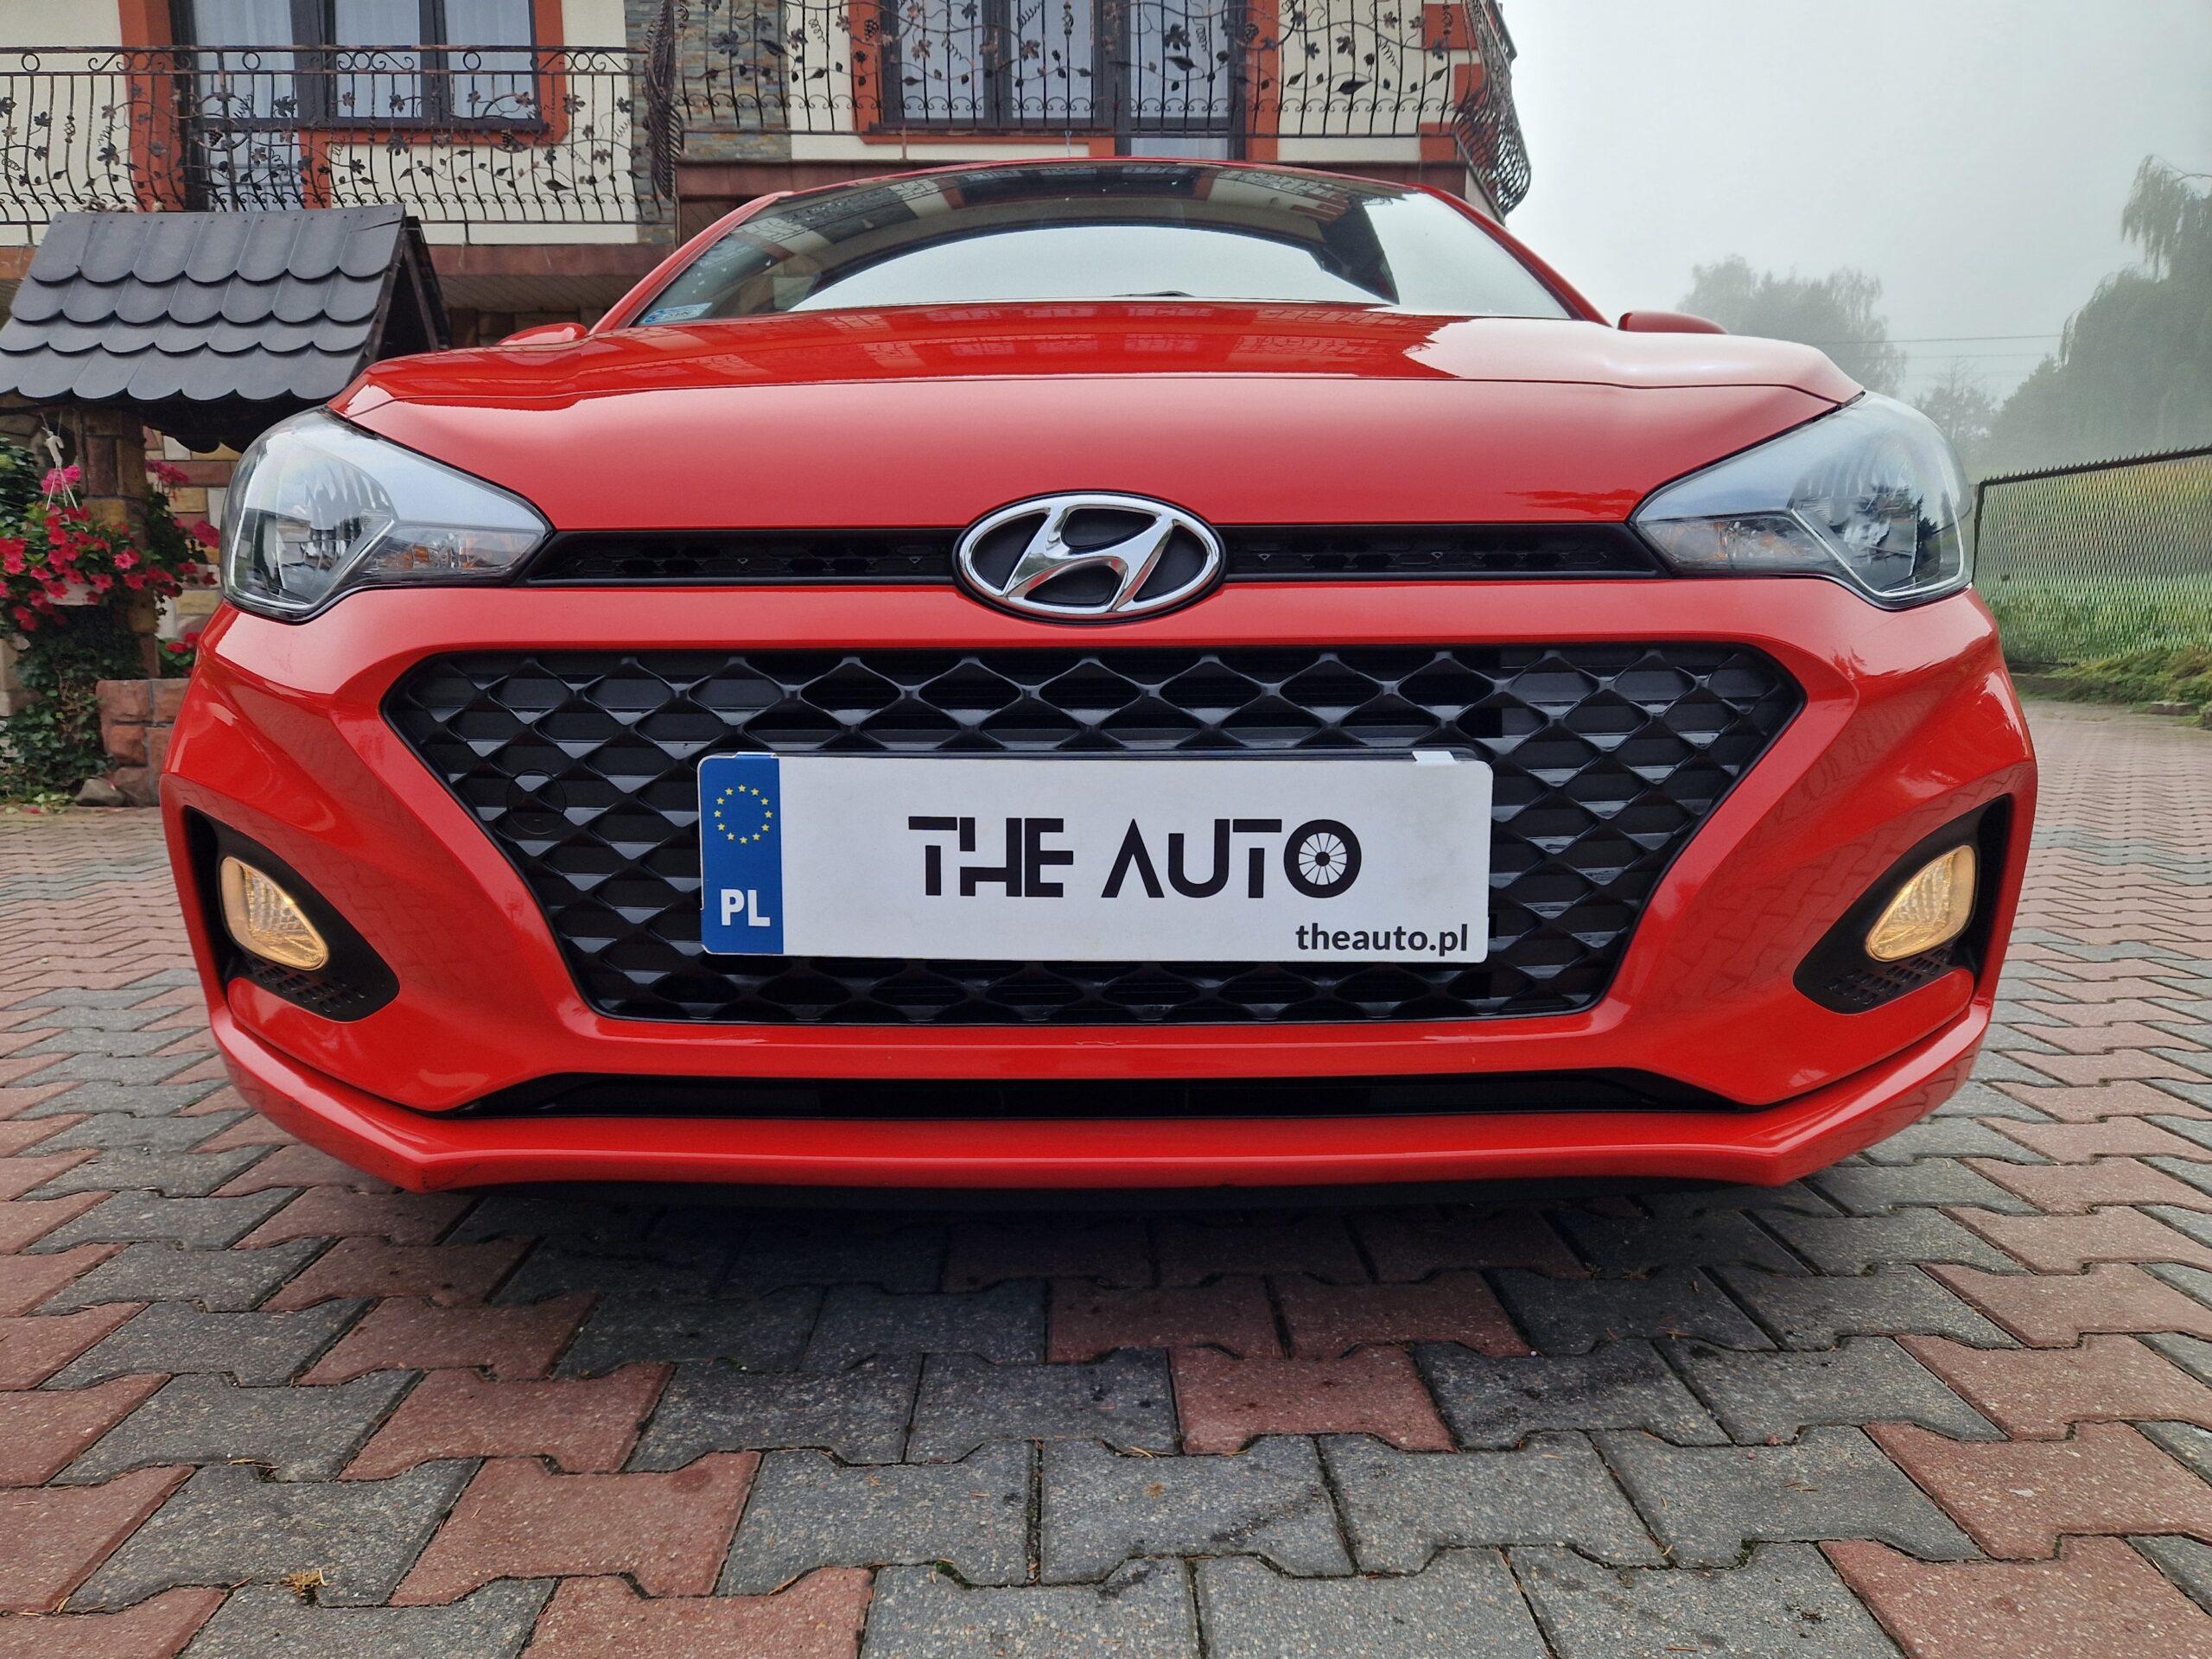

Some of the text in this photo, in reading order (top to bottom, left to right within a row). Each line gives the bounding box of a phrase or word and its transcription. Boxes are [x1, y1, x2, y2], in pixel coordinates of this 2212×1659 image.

[908, 817, 1363, 899] THE AUTO
[721, 888, 771, 927] PL
[1296, 923, 1468, 957] theauto.pl
